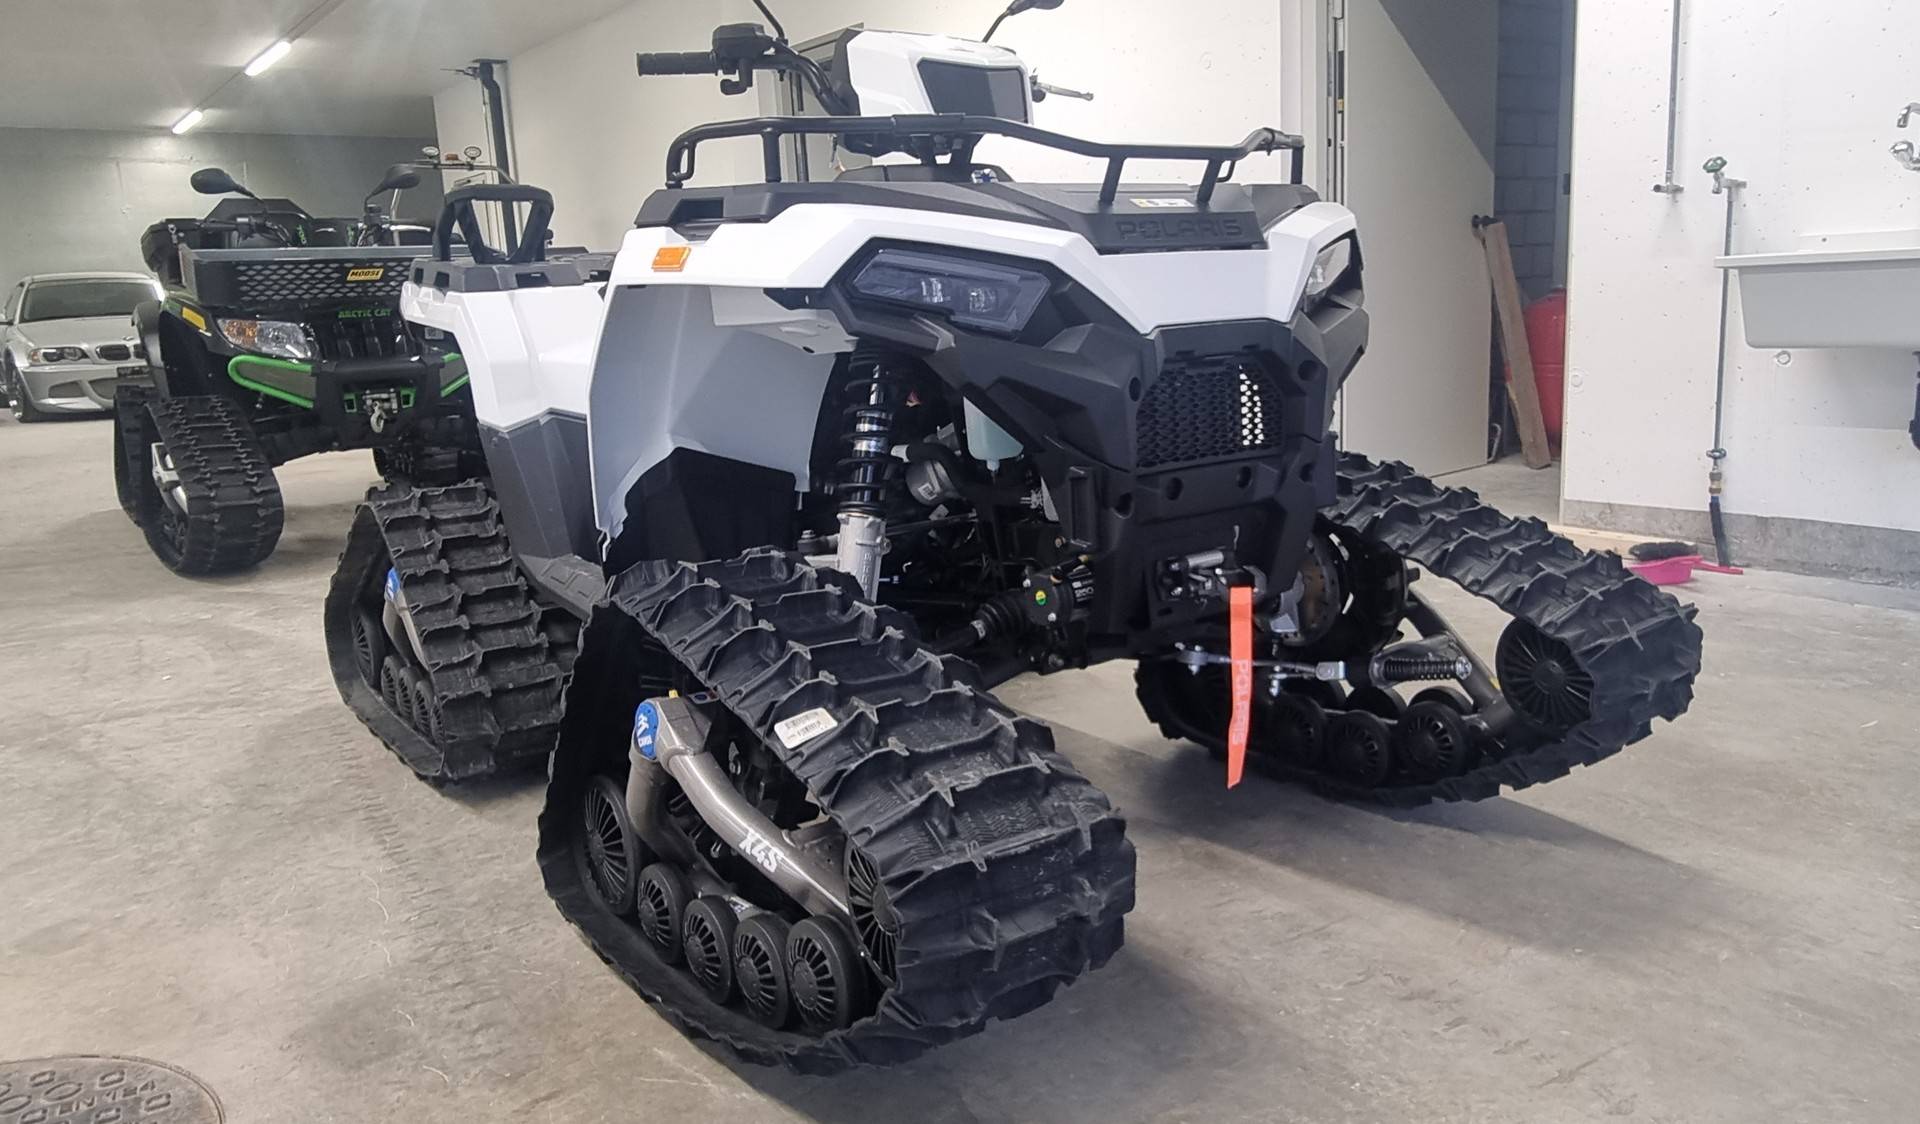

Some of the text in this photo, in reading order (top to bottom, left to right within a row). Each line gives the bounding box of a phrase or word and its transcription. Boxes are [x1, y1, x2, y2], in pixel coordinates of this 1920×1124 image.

[1116, 218, 1243, 240] POLARIS
[338, 307, 392, 319] ARCTIC CAT
[1232, 659, 1250, 745] POLARIS
[738, 831, 784, 874] X4S
